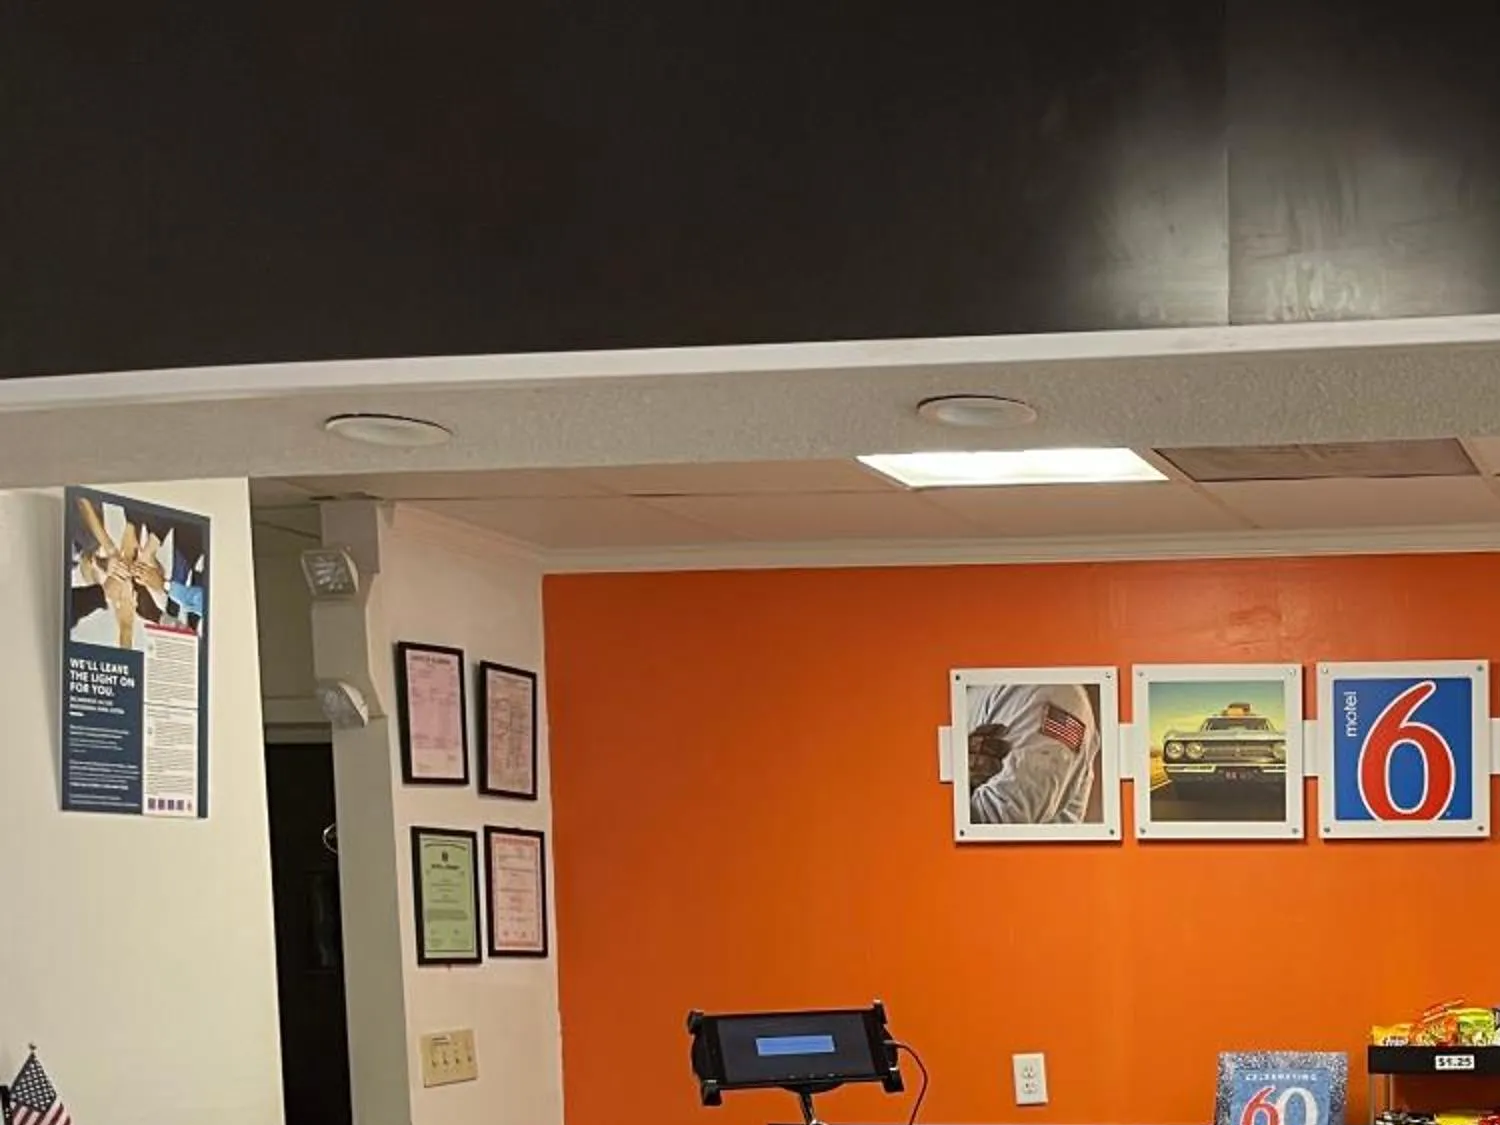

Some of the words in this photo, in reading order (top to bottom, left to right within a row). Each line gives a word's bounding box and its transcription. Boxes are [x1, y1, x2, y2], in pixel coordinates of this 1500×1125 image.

[70, 657, 98, 671] WE'LL
[100, 662, 129, 675] LEAVE
[70, 669, 89, 682] THE
[91, 672, 118, 686] LIGHT
[119, 676, 135, 688] ON
[70, 682, 89, 693] FOR
[92, 685, 115, 697] YOU.
[1343, 691, 1357, 737] motel
[1357, 680, 1456, 822] 6
[1437, 1056, 1472, 1067] $1.25
